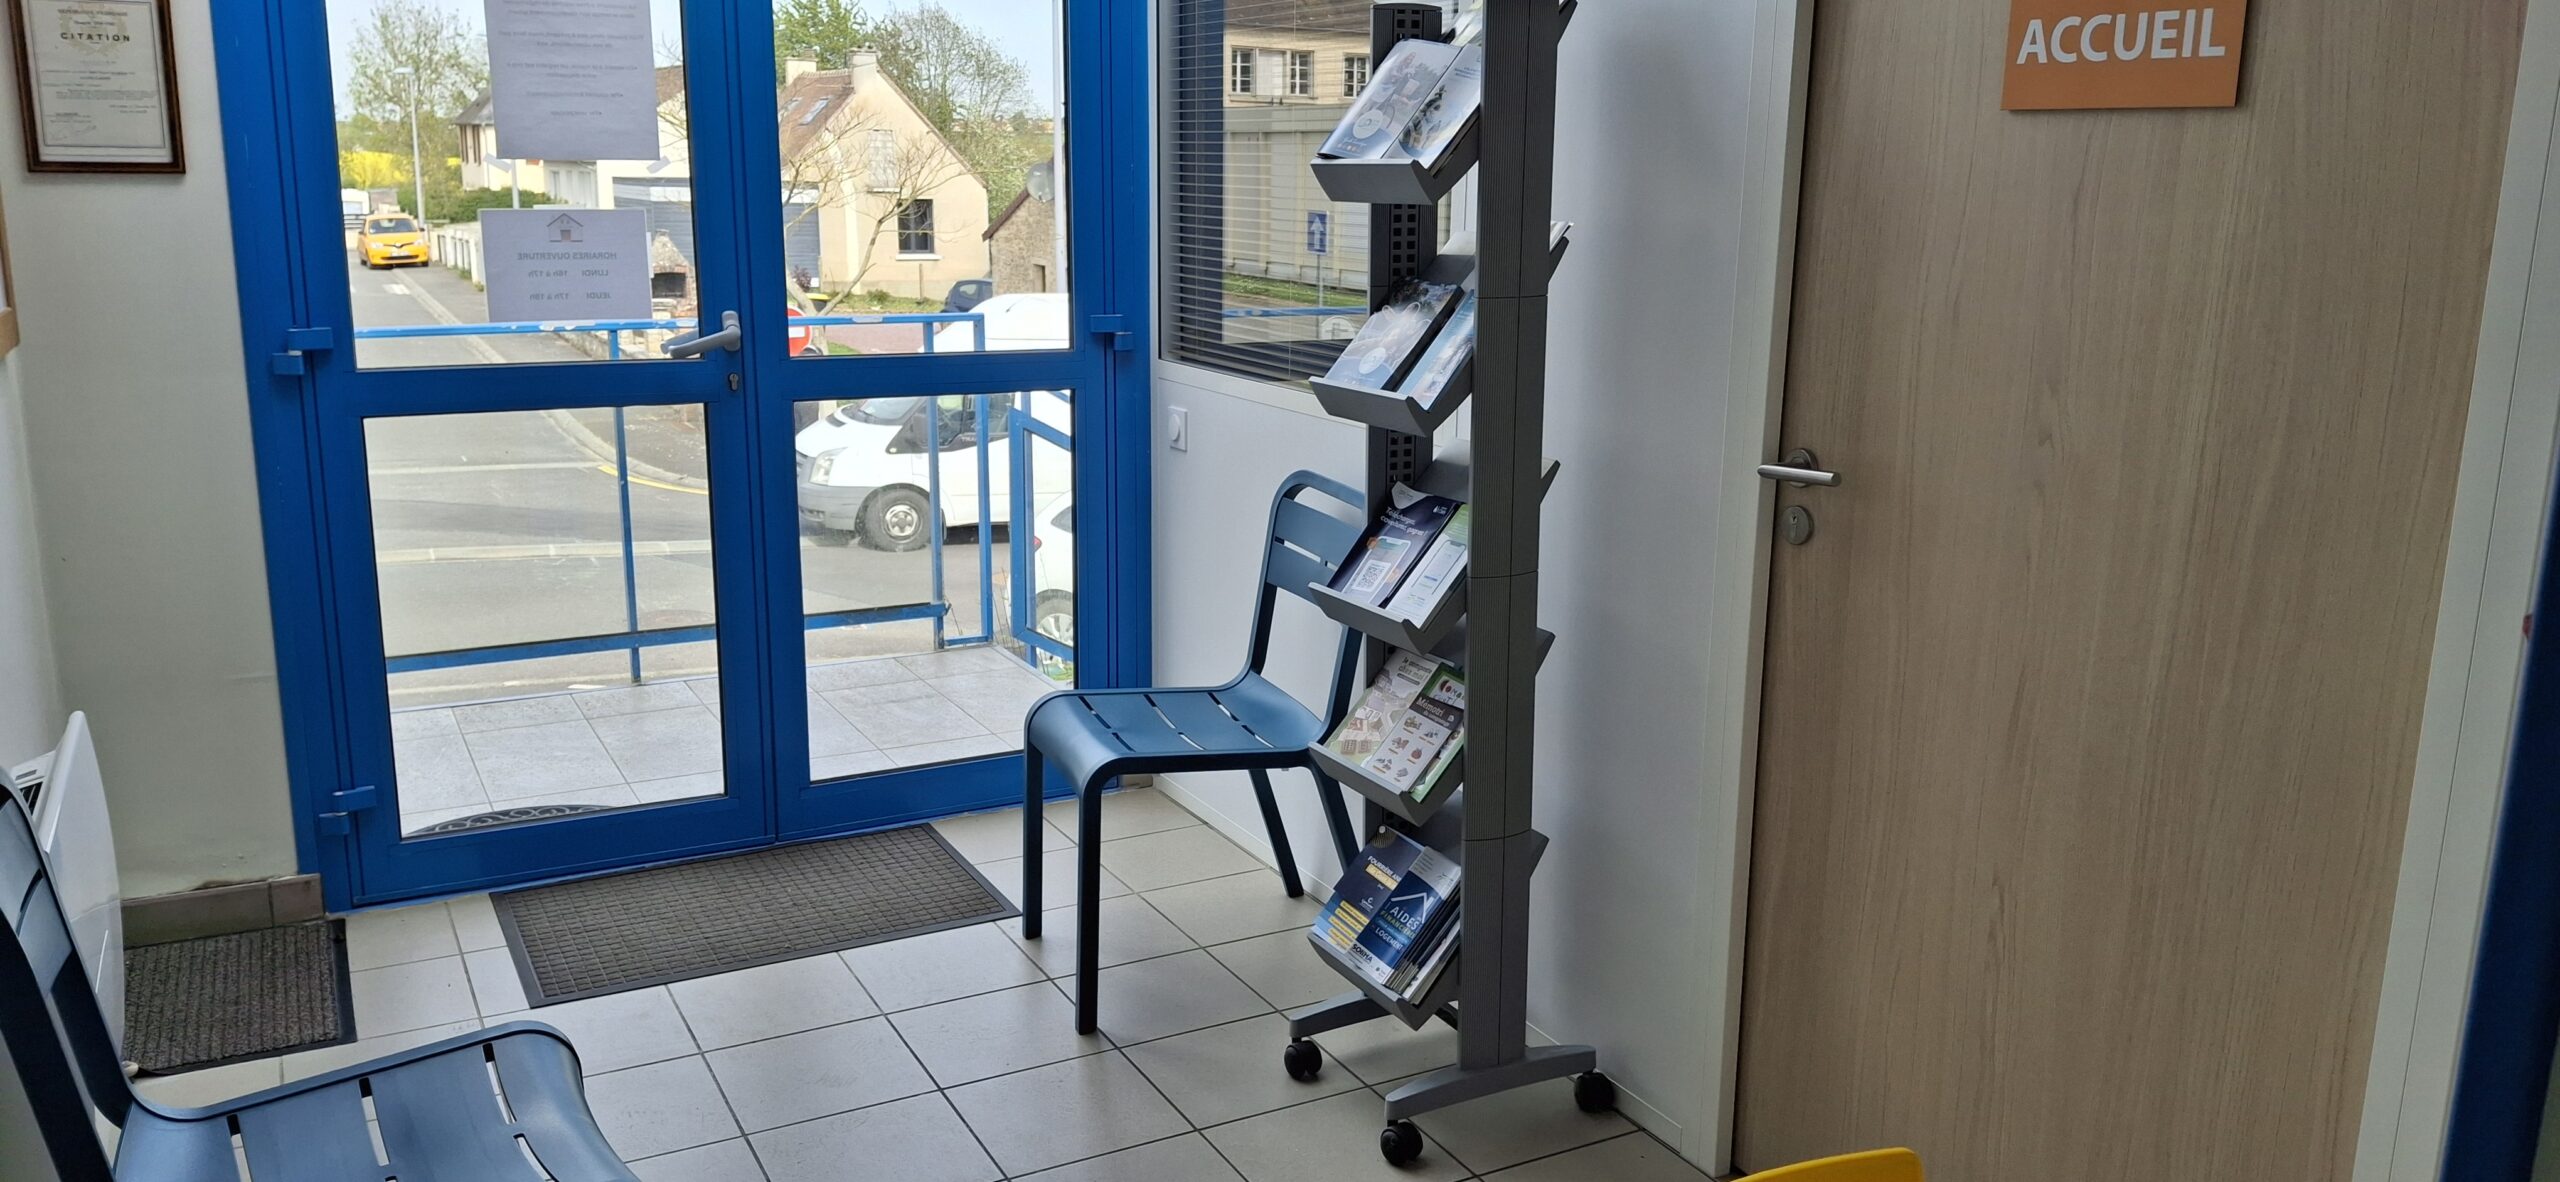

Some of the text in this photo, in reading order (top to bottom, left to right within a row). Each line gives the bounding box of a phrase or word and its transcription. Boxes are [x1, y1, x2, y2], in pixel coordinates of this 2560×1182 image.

[60, 32, 130, 42] CITATION
[2016, 8, 2225, 65] ACCUEIL
[1390, 906, 1421, 930] AIDES
[1375, 927, 1404, 950] LOGEMENT
